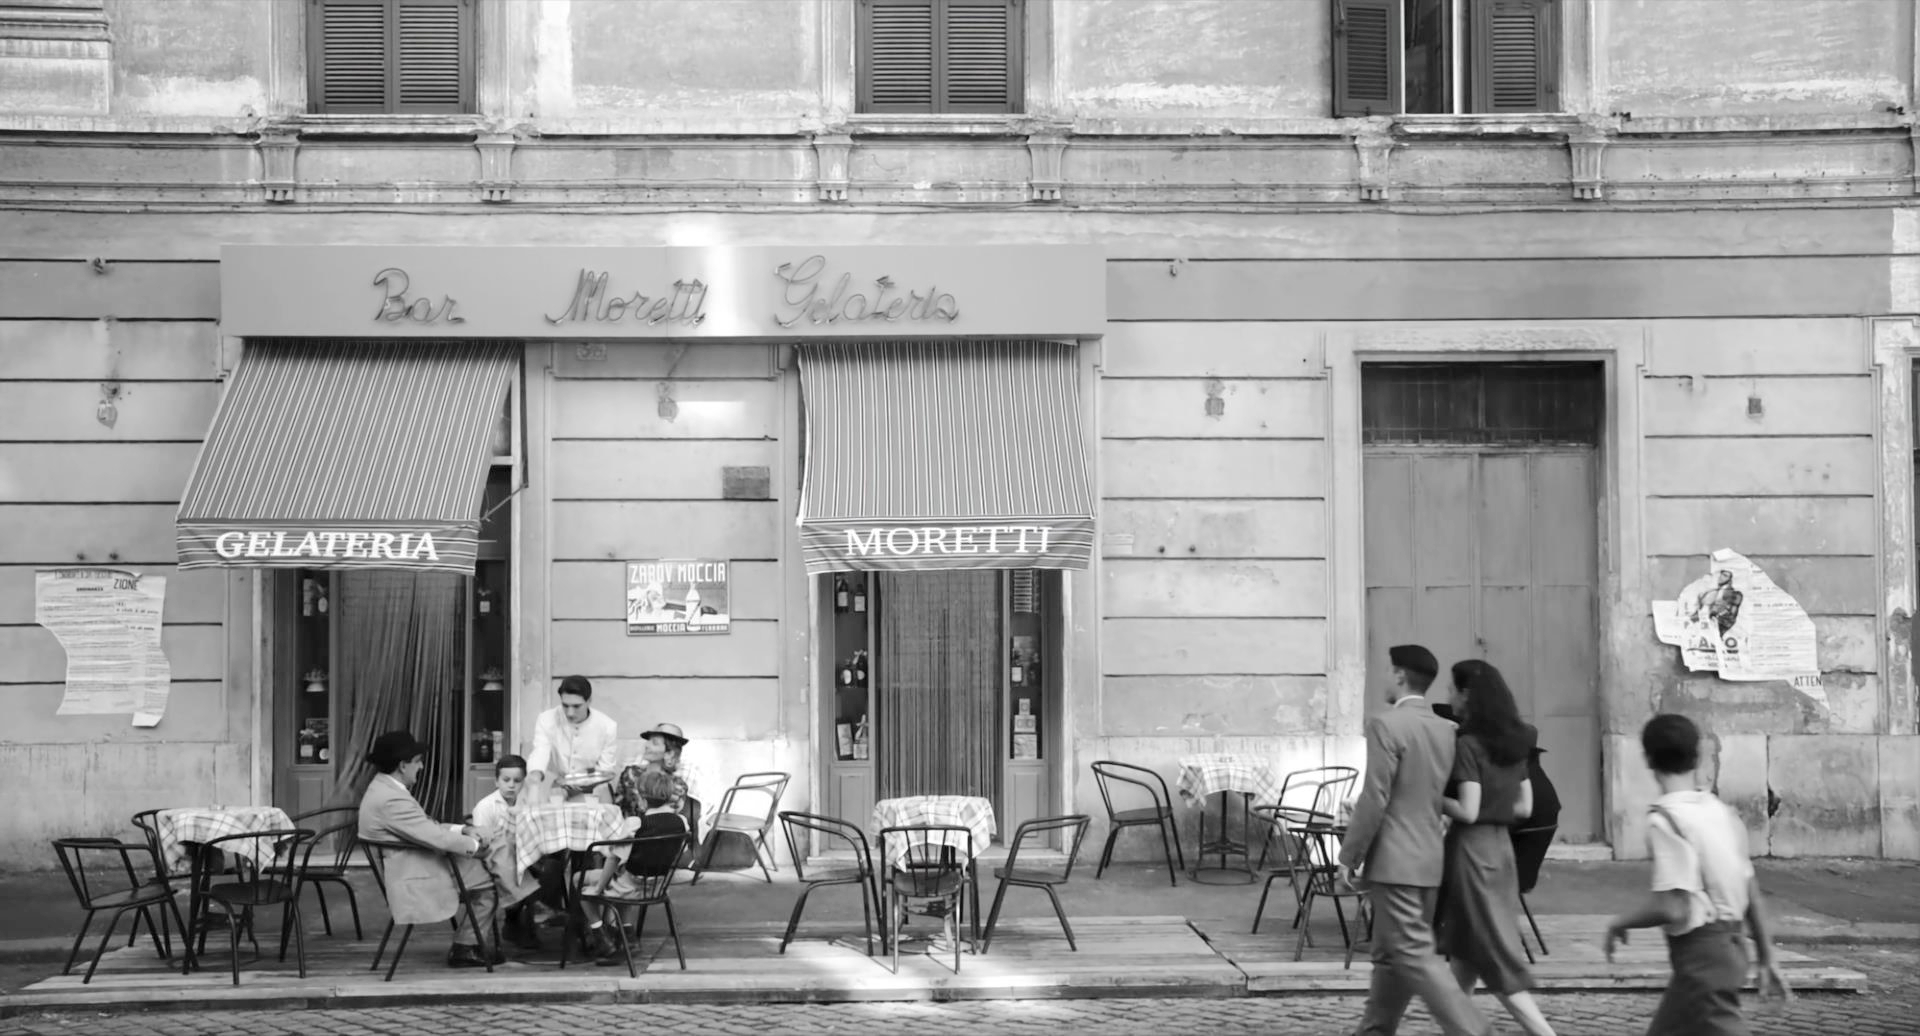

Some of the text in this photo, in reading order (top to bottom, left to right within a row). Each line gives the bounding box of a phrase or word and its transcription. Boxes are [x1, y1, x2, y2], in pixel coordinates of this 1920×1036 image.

[373, 255, 960, 328] Bar Moretti Gelateria
[215, 531, 440, 561] GELATERIA
[844, 525, 1053, 556] MORETTI
[677, 562, 727, 583] MOCCIA
[113, 578, 140, 591] ZIONE
[656, 623, 687, 633] MOCCIA
[1794, 675, 1822, 688] ATTEN
